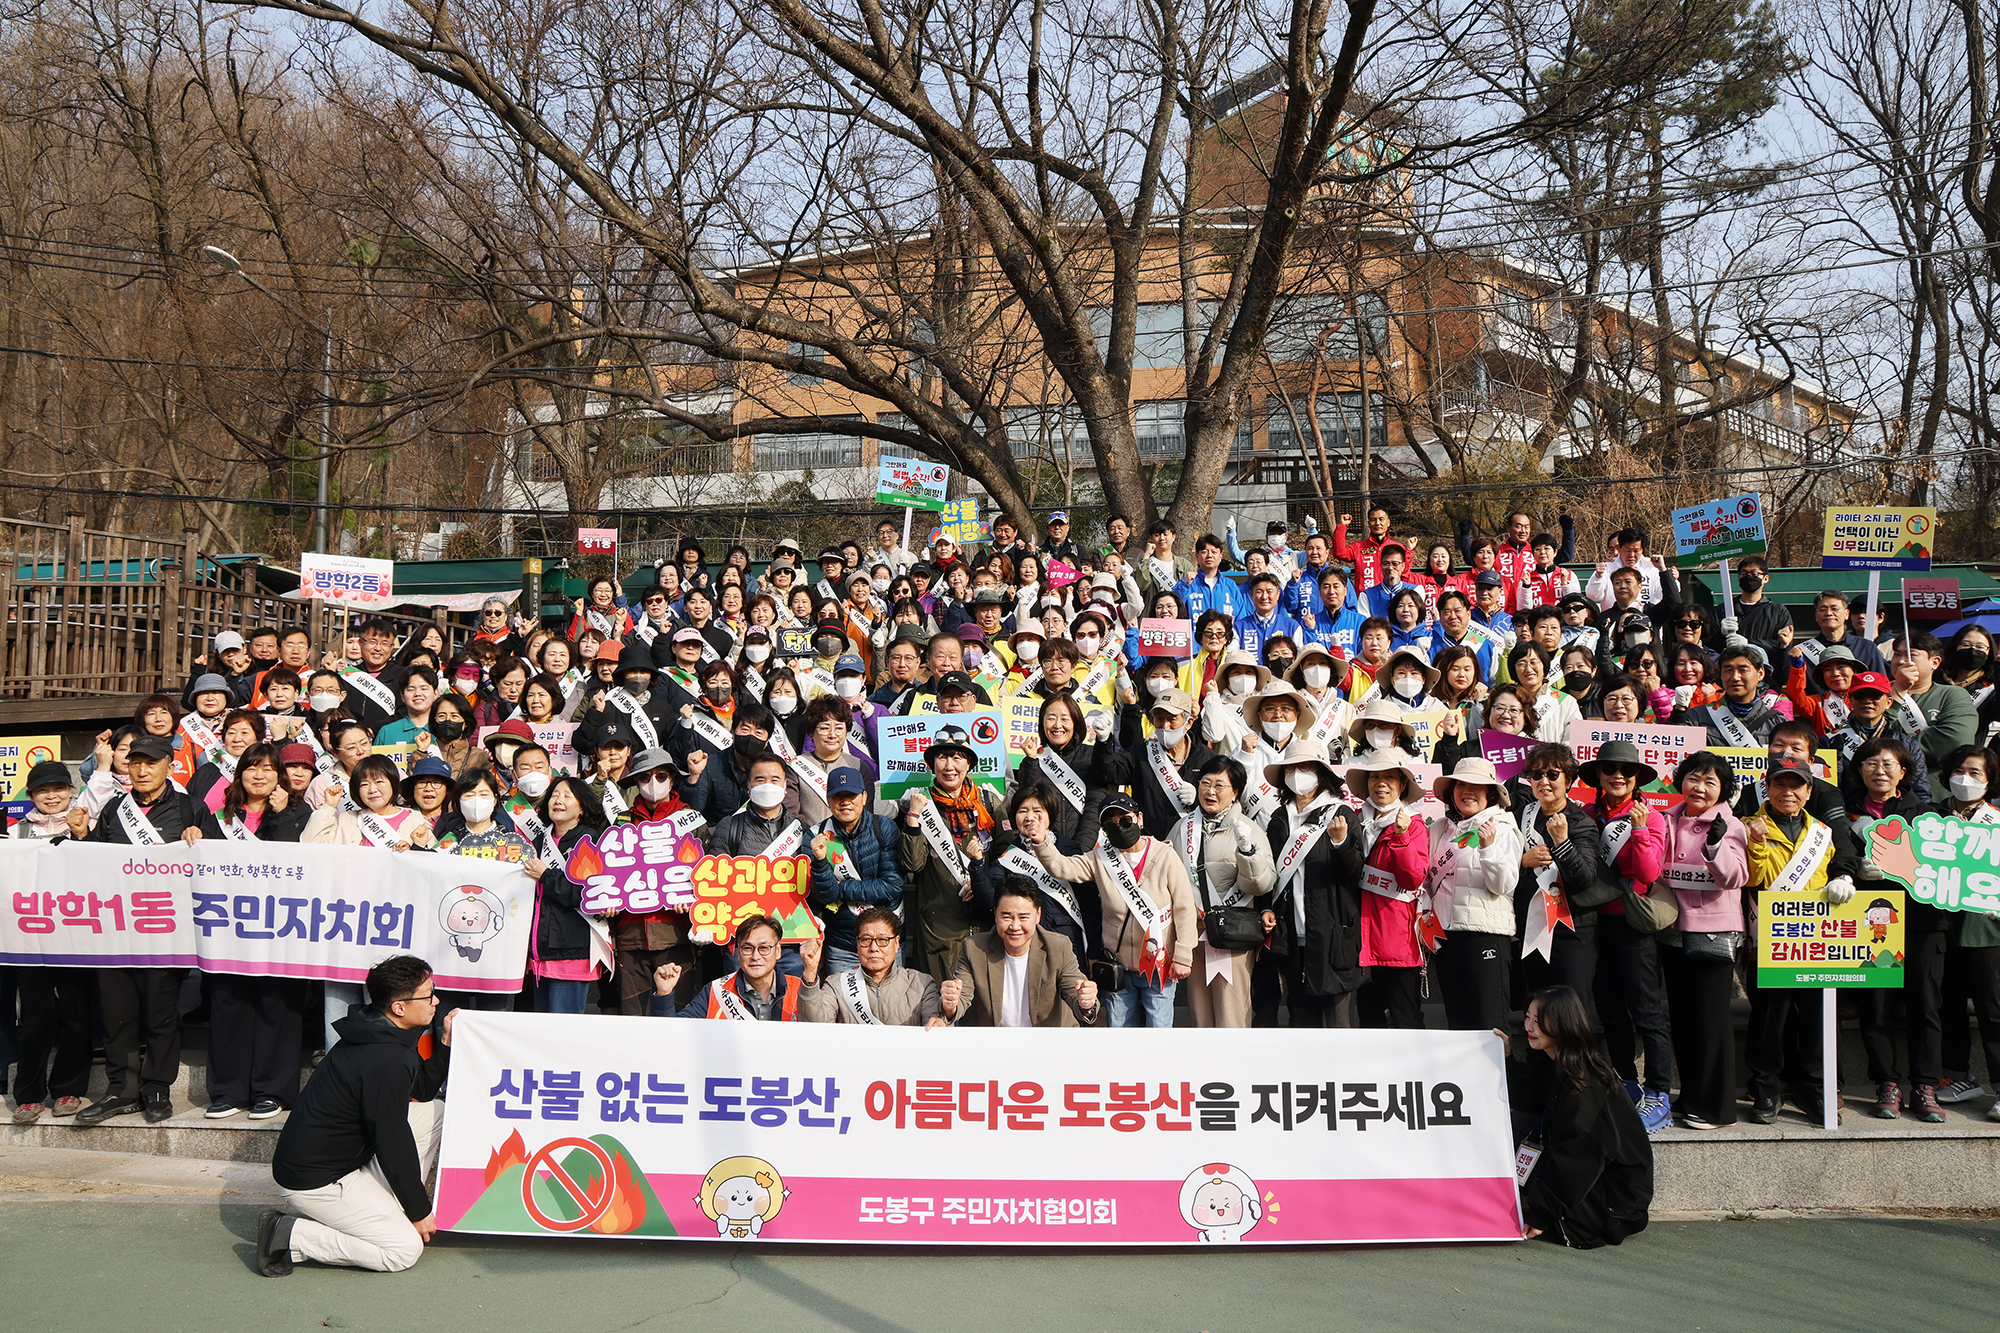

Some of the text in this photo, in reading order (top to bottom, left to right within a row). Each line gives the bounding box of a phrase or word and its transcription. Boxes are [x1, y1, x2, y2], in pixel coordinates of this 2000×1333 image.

[893, 470, 930, 483] 불법 소각!
[905, 485, 922, 495] 산불
[923, 488, 942, 498] 예방!
[941, 500, 978, 522] 산불
[1678, 509, 1705, 524] 그만해요
[1835, 514, 1902, 523] 라이터 소지 금지
[942, 521, 979, 541] 예방
[1691, 513, 1738, 532] 불법 소각!
[1834, 526, 1900, 538] 선택이 아닌
[582, 537, 612, 549] 창1동
[1680, 526, 1759, 546] 함께해요 산불 예방!
[1833, 540, 1895, 552] 의무입니다
[315, 571, 379, 592] 방학2동
[1050, 571, 1062, 579] 방학
[1909, 592, 1958, 609] 도봉2동
[1141, 631, 1188, 648] 방학3동
[355, 674, 376, 693] 도봉구
[616, 693, 635, 716] 도봉구
[696, 717, 720, 738] 도봉구
[886, 722, 927, 738] 그만해요
[1323, 713, 1336, 730] 불씨
[1720, 716, 1743, 743] 도봉구
[197, 730, 213, 747] 불씨
[539, 731, 565, 740] 수십 년
[904, 737, 931, 753] 불법
[1591, 731, 1685, 746] 숲을 키운 건 수십 년
[562, 743, 573, 756] 분
[1644, 750, 1677, 766] 단 몇
[0, 762, 17, 777] 닌
[886, 759, 927, 773] 함께해요
[1042, 755, 1065, 779] 도봉구
[1159, 766, 1179, 792] 한순간
[119, 802, 140, 827] 도봉구
[677, 809, 701, 827] 주민
[922, 809, 942, 838] 도봉구
[361, 814, 386, 840] 도봉구
[600, 825, 677, 868] 산불
[1918, 816, 2000, 866] 함께
[1280, 831, 1310, 873] 흡연NO!
[122, 858, 194, 878] dobong
[196, 863, 215, 876] 같이
[247, 864, 281, 878] 행복한
[285, 867, 304, 881] 도봉
[1011, 856, 1038, 878] 도봉구
[1789, 857, 1811, 884] 라이터
[694, 858, 808, 897] 산과의
[1366, 872, 1393, 891] 불씨
[1914, 863, 2000, 911] 해요
[584, 865, 694, 910] 조심은
[1117, 870, 1154, 922] 주민자치협
[1771, 901, 1830, 917] 여러분이
[12, 891, 415, 950] 방학1동 주민자치회
[1771, 919, 1857, 938] 도봉산 산불
[1771, 942, 1872, 961] 감시원입니다
[1795, 974, 1866, 982] 도봉구 주민자치협의회
[490, 1069, 1472, 1134] 산불 없는 도봉산, 아름다운 도봉산을 지켜주세요
[1518, 1153, 1534, 1166] 진행
[859, 1196, 1118, 1226] 도봉구 주민자치협의회
